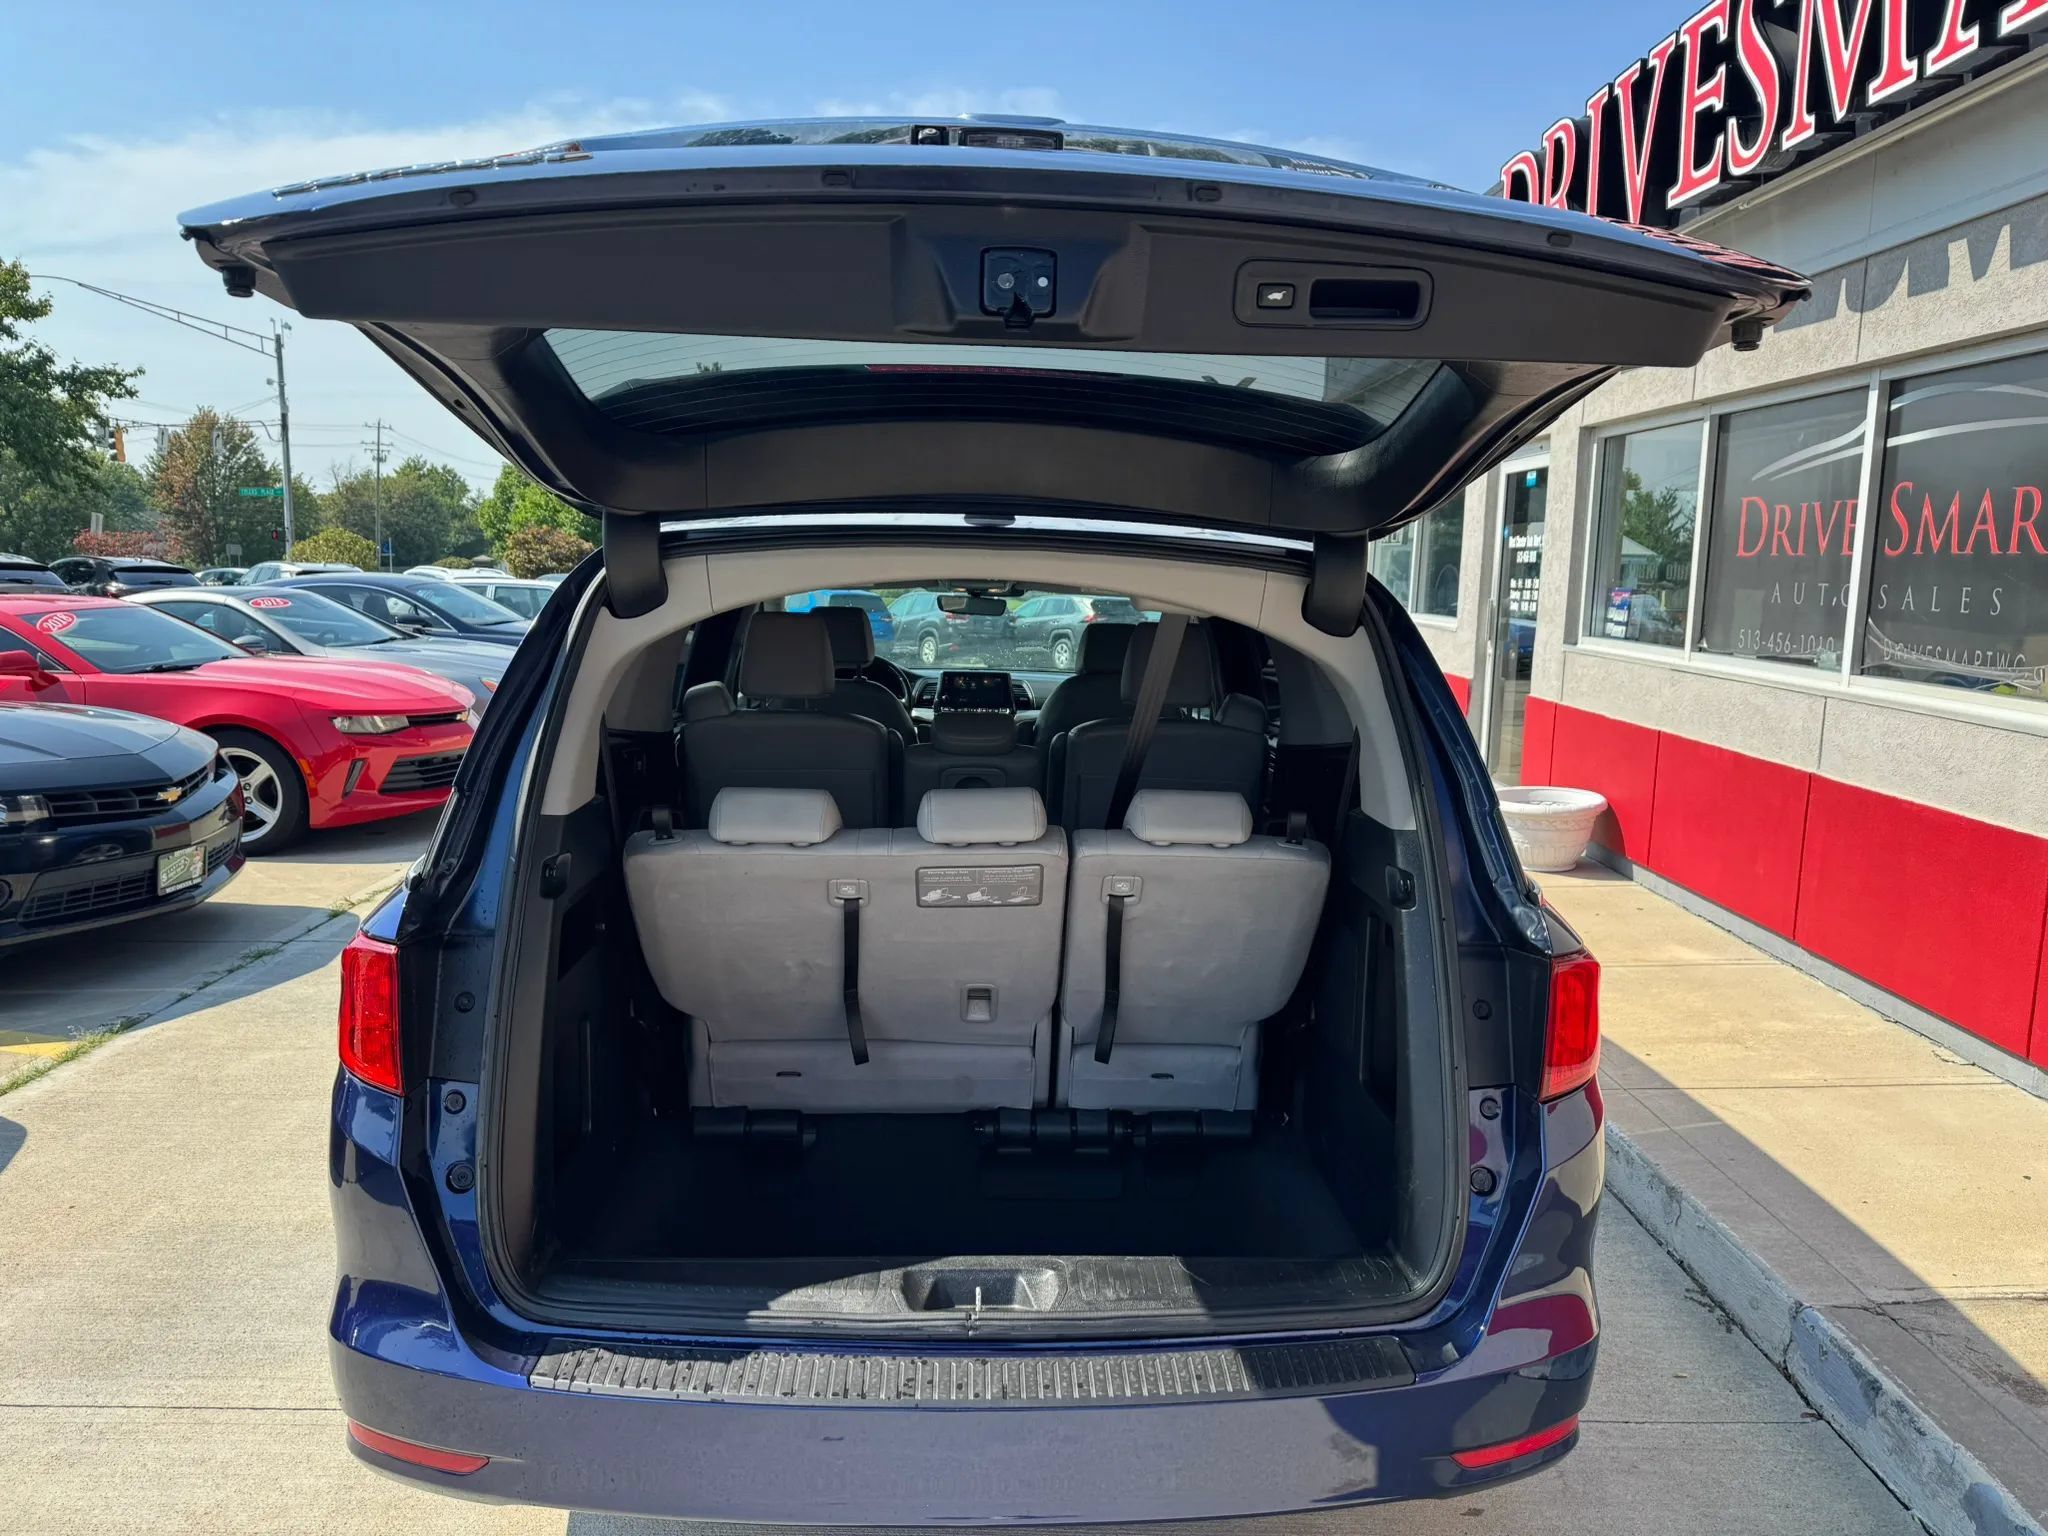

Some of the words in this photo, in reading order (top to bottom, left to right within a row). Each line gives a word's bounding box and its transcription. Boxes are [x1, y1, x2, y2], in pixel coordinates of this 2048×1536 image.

[1736, 497, 1858, 557] DRIVE
[1884, 481, 2048, 556] SMAR
[1878, 584, 2003, 616] SALES
